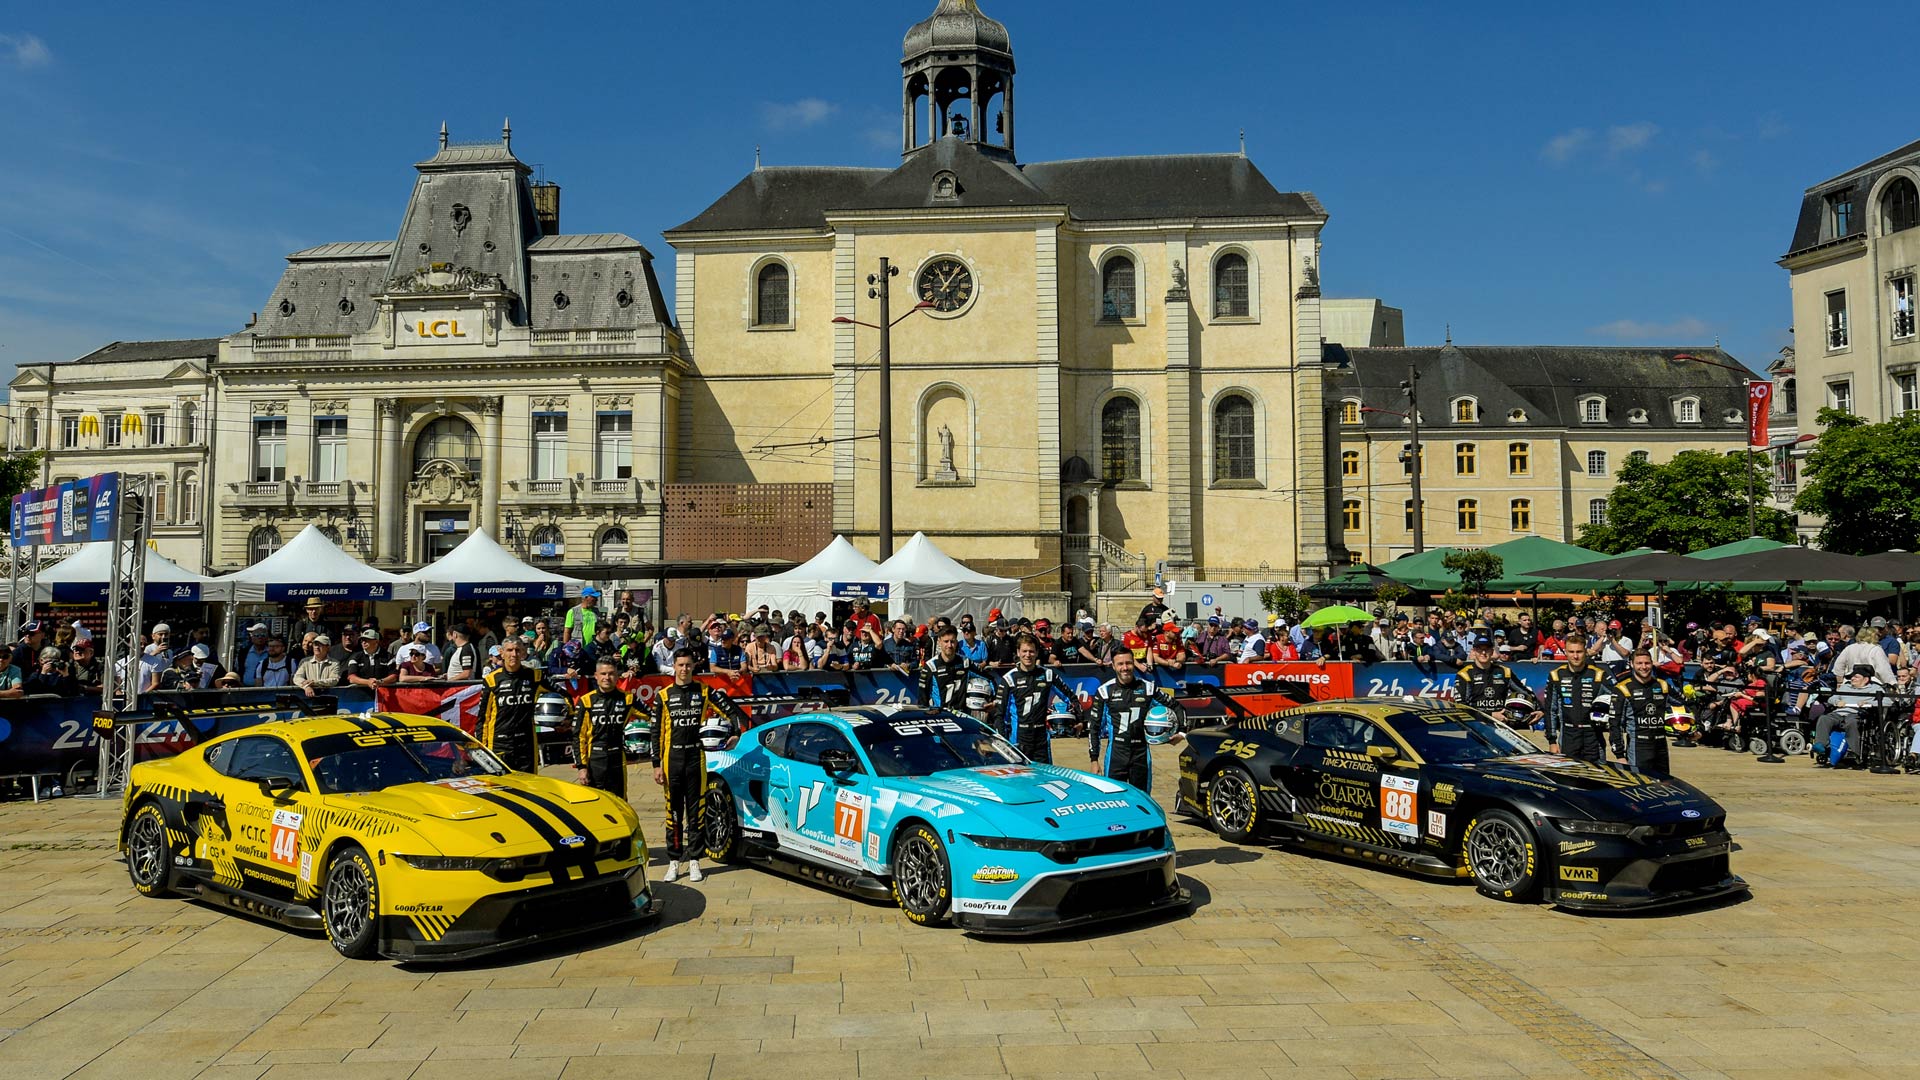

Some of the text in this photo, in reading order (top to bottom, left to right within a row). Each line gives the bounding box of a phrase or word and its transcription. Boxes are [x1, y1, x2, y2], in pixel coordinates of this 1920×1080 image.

[418, 320, 466, 337] LCL
[298, 588, 348, 596] AUTOMOBILES
[1368, 678, 1404, 697] 24h
[93, 717, 113, 729] FORD
[889, 718, 953, 728] MUSTANG
[894, 723, 962, 736] GT3
[347, 727, 429, 738] MUSTANG
[353, 731, 437, 747] GT3
[1215, 738, 1260, 759] SAS
[1435, 782, 1455, 792] BLUE
[1619, 784, 1689, 802] IKIGAI
[1432, 789, 1457, 801] WATER
[1051, 800, 1130, 817] 1ST PHORM
[1321, 805, 1363, 819] GOODYEAR
[1385, 791, 1412, 820] 88
[840, 806, 858, 838] 77
[1432, 813, 1443, 825] LM
[801, 827, 835, 843] GOODYEAR
[1430, 824, 1443, 836] GT3
[273, 828, 296, 863] 44
[918, 828, 939, 850] EAGLE
[1557, 840, 1597, 852] Milwaukee
[235, 843, 268, 860] GOODYEAR
[1462, 818, 1477, 878] GOODYEAR
[1525, 843, 1536, 877] EAGLE
[1564, 868, 1594, 880] VMR
[1560, 890, 1608, 901] GOODYEAR
[394, 902, 444, 914] GOODYEAR
[963, 901, 1008, 911] GOODYEAR
